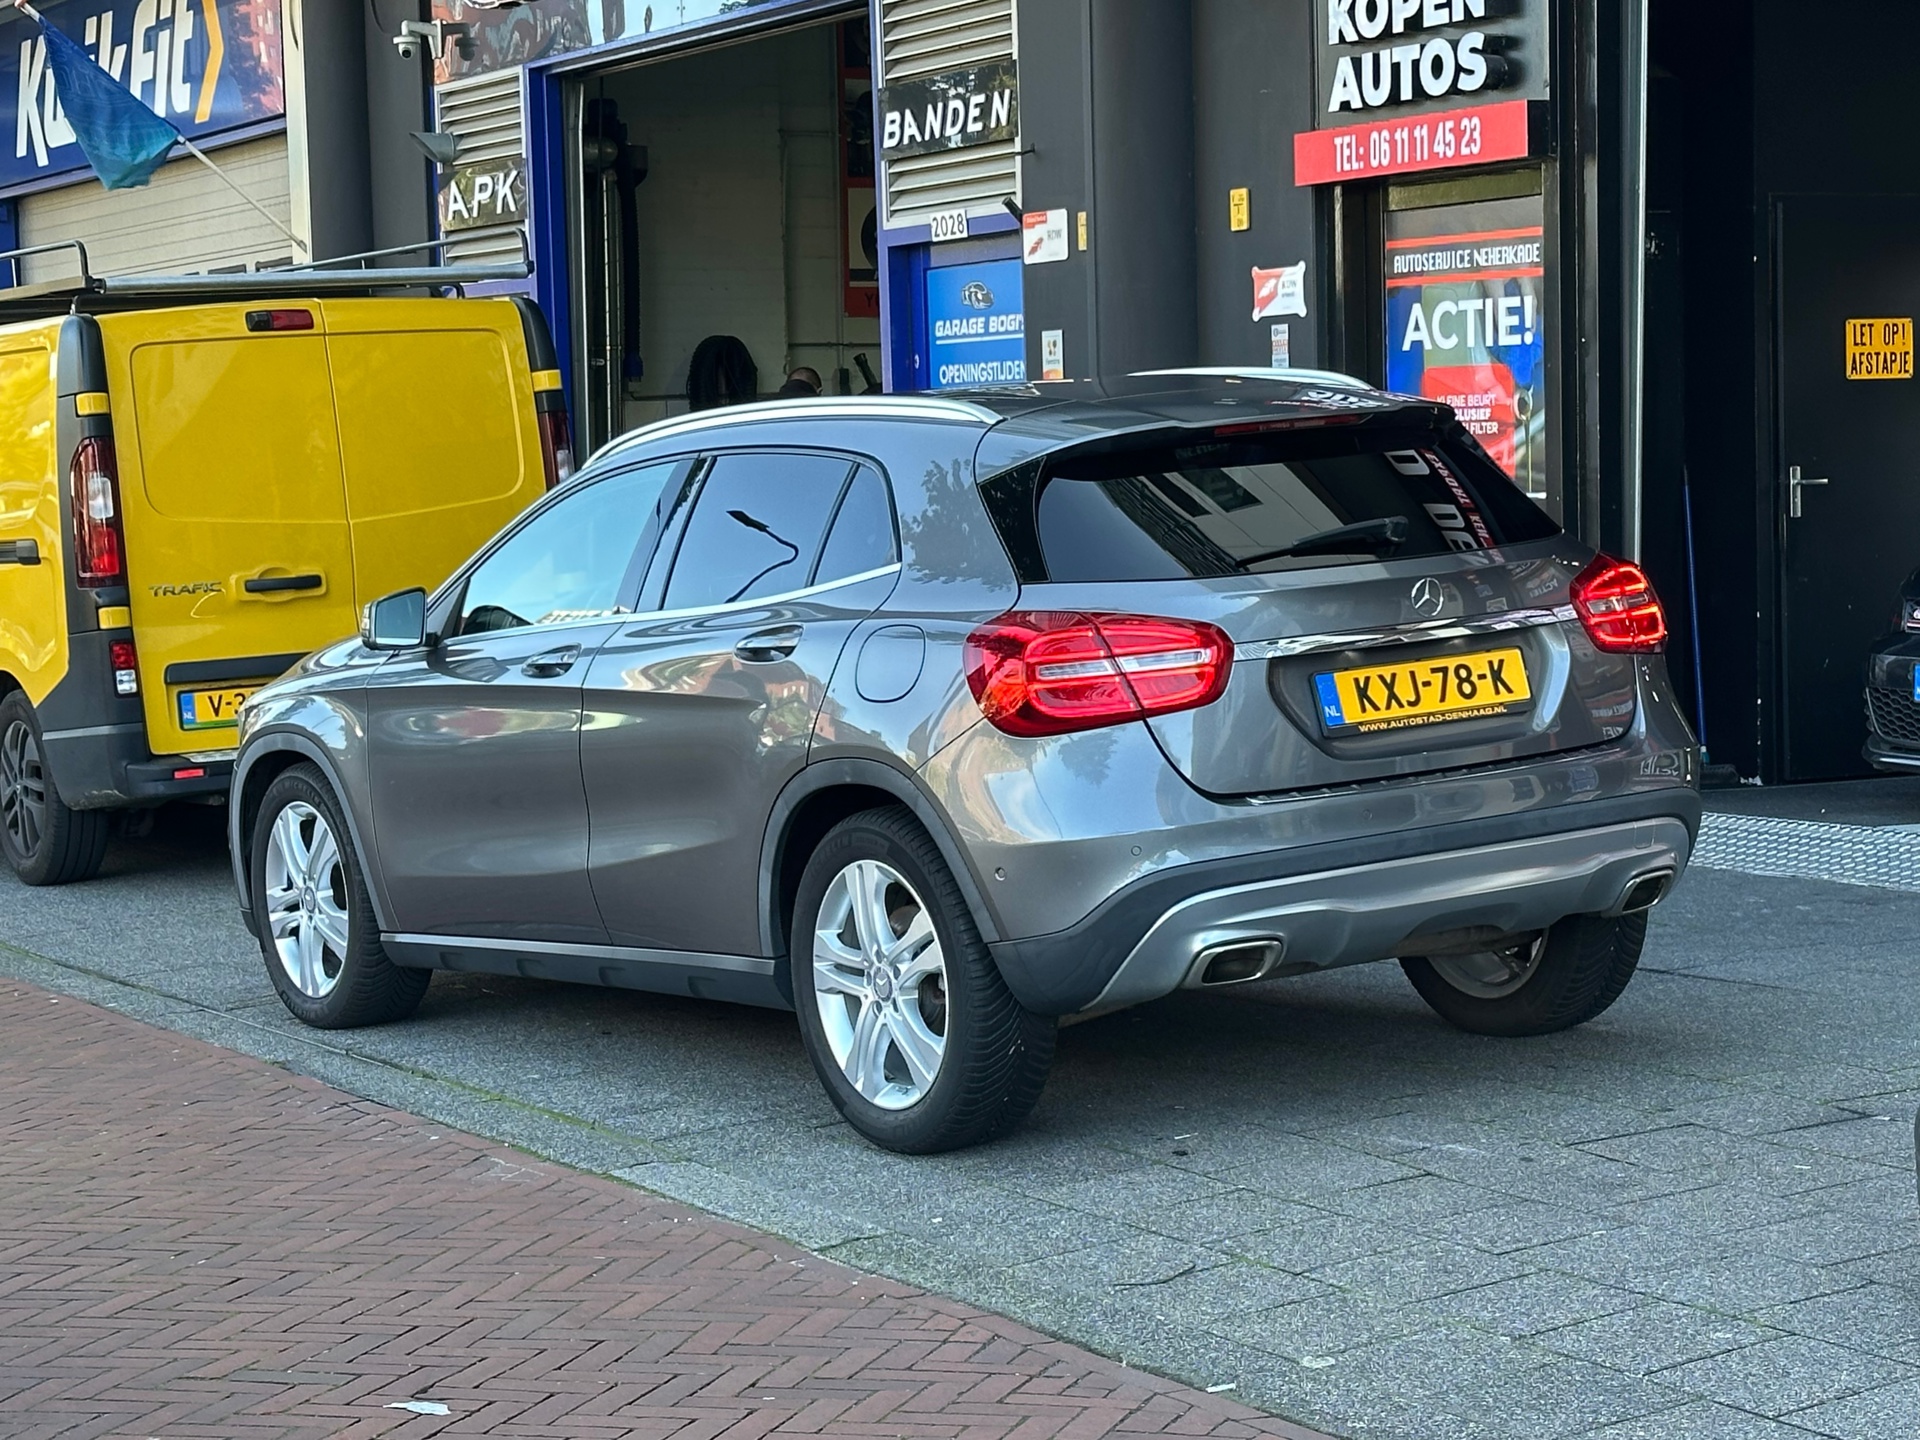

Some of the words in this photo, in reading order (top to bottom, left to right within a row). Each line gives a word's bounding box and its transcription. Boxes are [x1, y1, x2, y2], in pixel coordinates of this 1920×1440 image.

[1327, 31, 1487, 113] AUTOS
[883, 89, 1010, 148] BANDEN
[1334, 136, 1364, 172] TEL:
[1370, 131, 1390, 168] 06
[1395, 127, 1409, 165] 11
[1414, 124, 1428, 162] 11
[1433, 120, 1455, 158] 45
[1460, 116, 1481, 155] 23
[447, 170, 518, 220] APK
[932, 213, 965, 238] 2028
[1393, 249, 1471, 274] AUTOSERVICE
[1473, 243, 1540, 267] NEHERKADE
[935, 316, 985, 337] GARAGE
[1402, 295, 1534, 352] ACTIE!
[1853, 323, 1874, 346] LET
[1883, 322, 1906, 346] OP!
[1851, 350, 1910, 375] AFSTAPJE
[1467, 391, 1496, 407] BEURT
[1470, 421, 1499, 434] FILTER
[149, 582, 222, 597] TRAFIC
[1353, 659, 1514, 714] KXJ-78-K
[183, 711, 195, 719] NL
[1325, 704, 1341, 718] NL
[1358, 705, 1508, 733] WWW.AUTOSTAD-DENHAAG.NL
